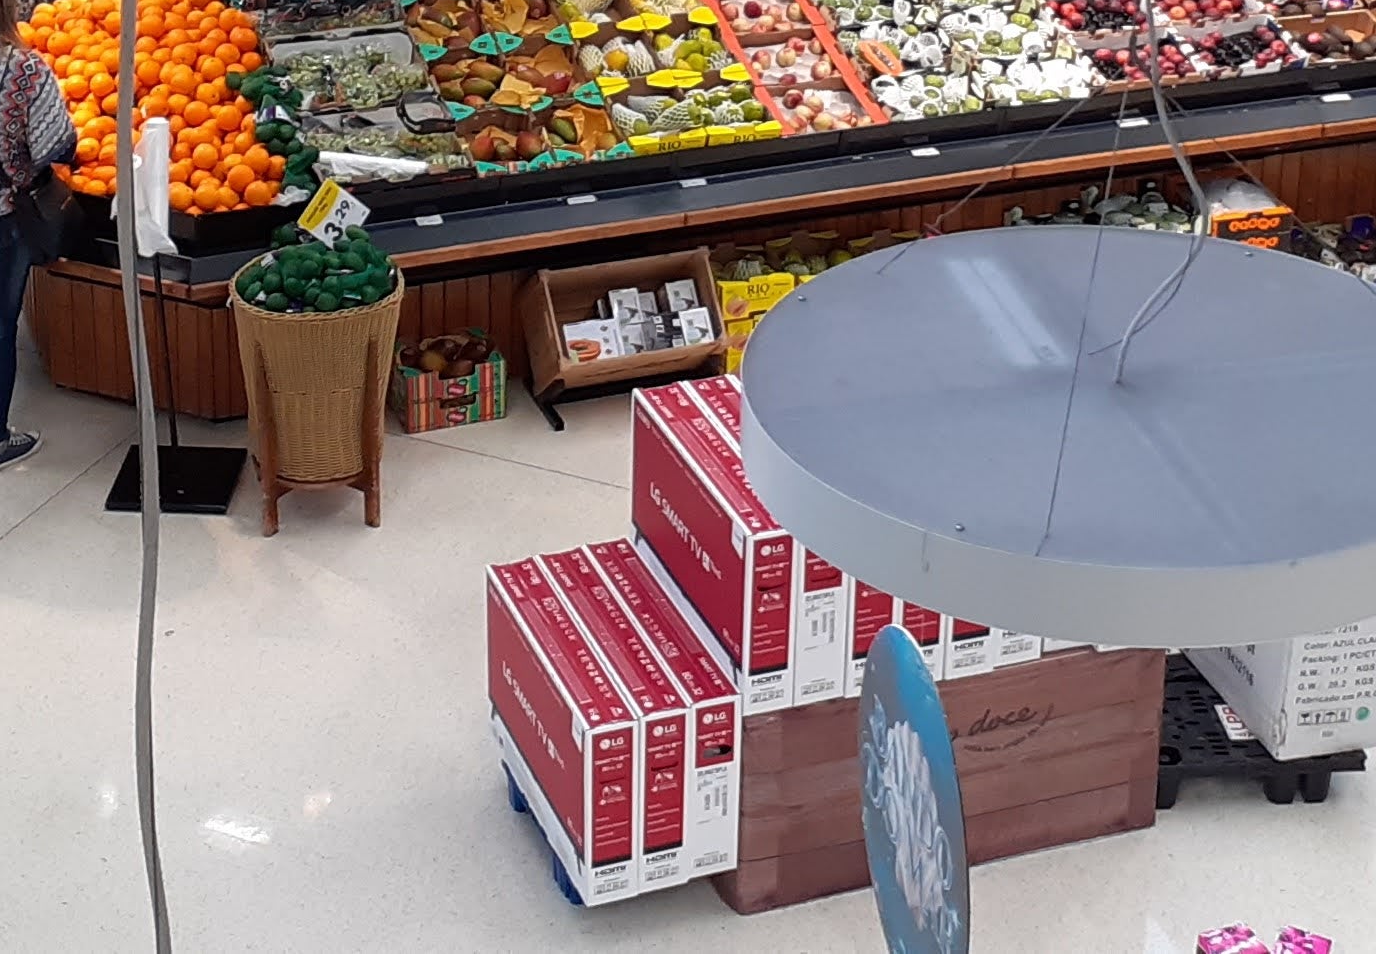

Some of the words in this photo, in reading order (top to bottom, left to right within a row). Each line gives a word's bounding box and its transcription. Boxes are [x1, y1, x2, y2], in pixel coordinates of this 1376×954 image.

[324, 199, 351, 242] 3,29
[662, 497, 690, 544] SMART
[772, 543, 785, 554] LG
[611, 737, 624, 748] LG
